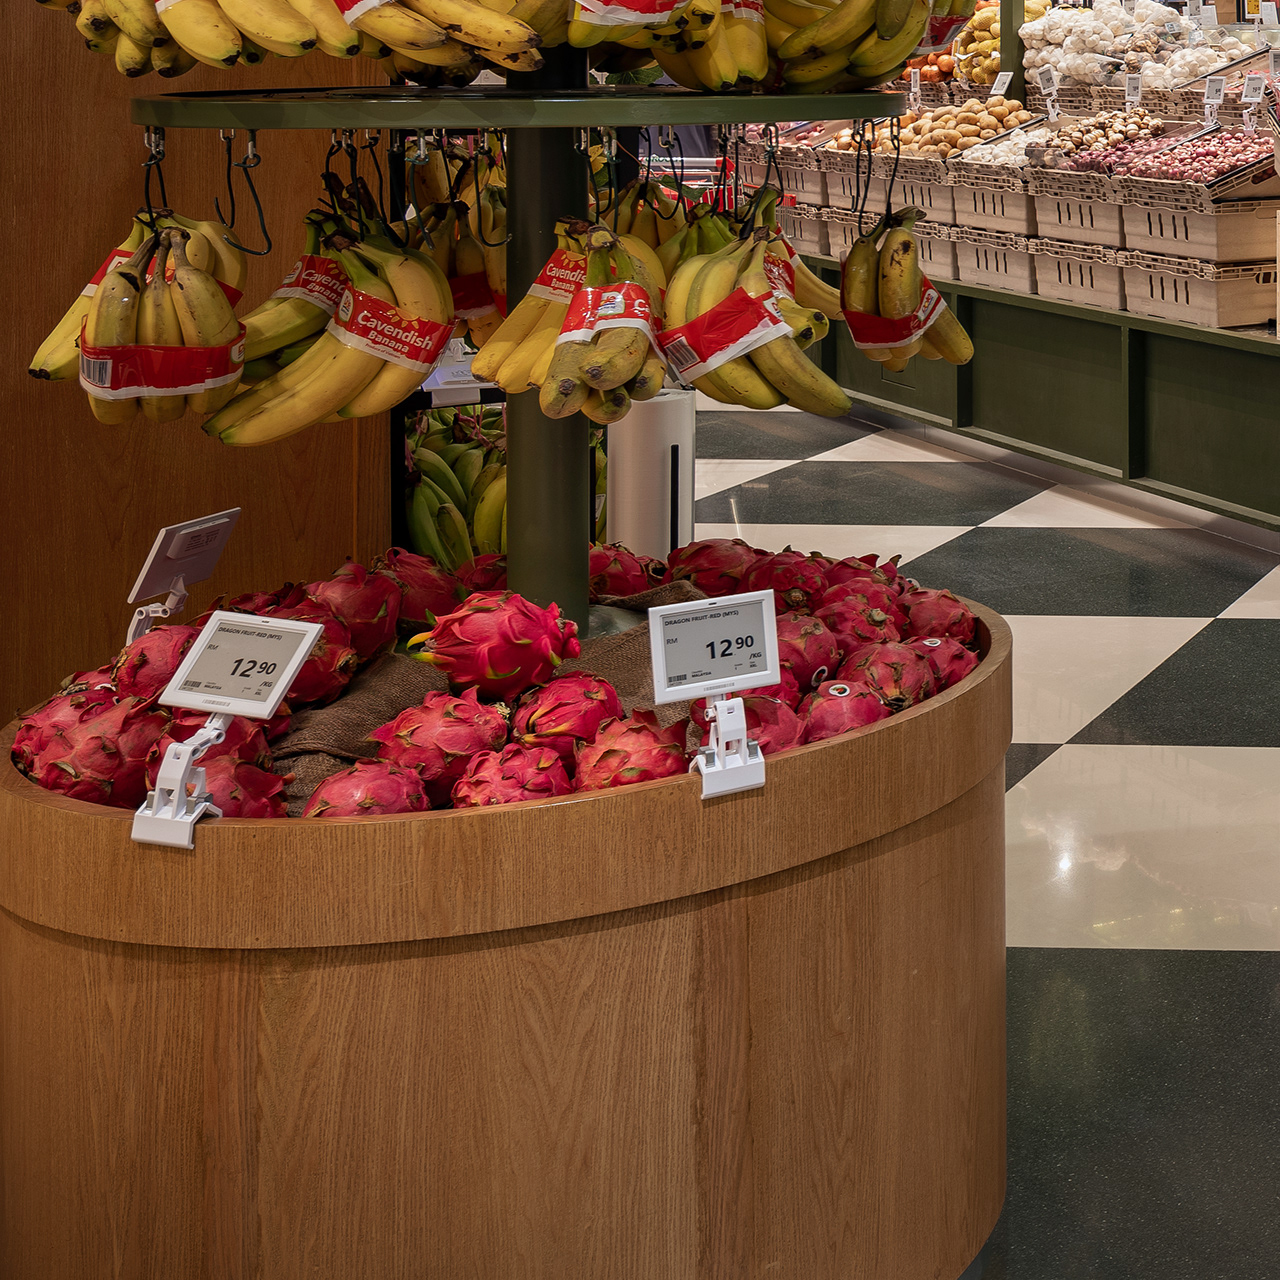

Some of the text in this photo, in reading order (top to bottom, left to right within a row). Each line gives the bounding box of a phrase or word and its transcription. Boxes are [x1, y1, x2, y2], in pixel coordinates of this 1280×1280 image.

[301, 269, 345, 294] Cavend
[546, 263, 587, 283] Cavendis
[306, 282, 342, 303] Banana
[551, 278, 576, 291] Banana
[357, 311, 433, 350] Cavendish
[368, 330, 410, 353] Banana
[665, 610, 739, 626] DRAGON FRUIT-RED (MYS)
[218, 626, 283, 641] DRAGON FRUIT-RED (MYS)
[666, 637, 678, 645] RM
[749, 652, 762, 660] /KG
